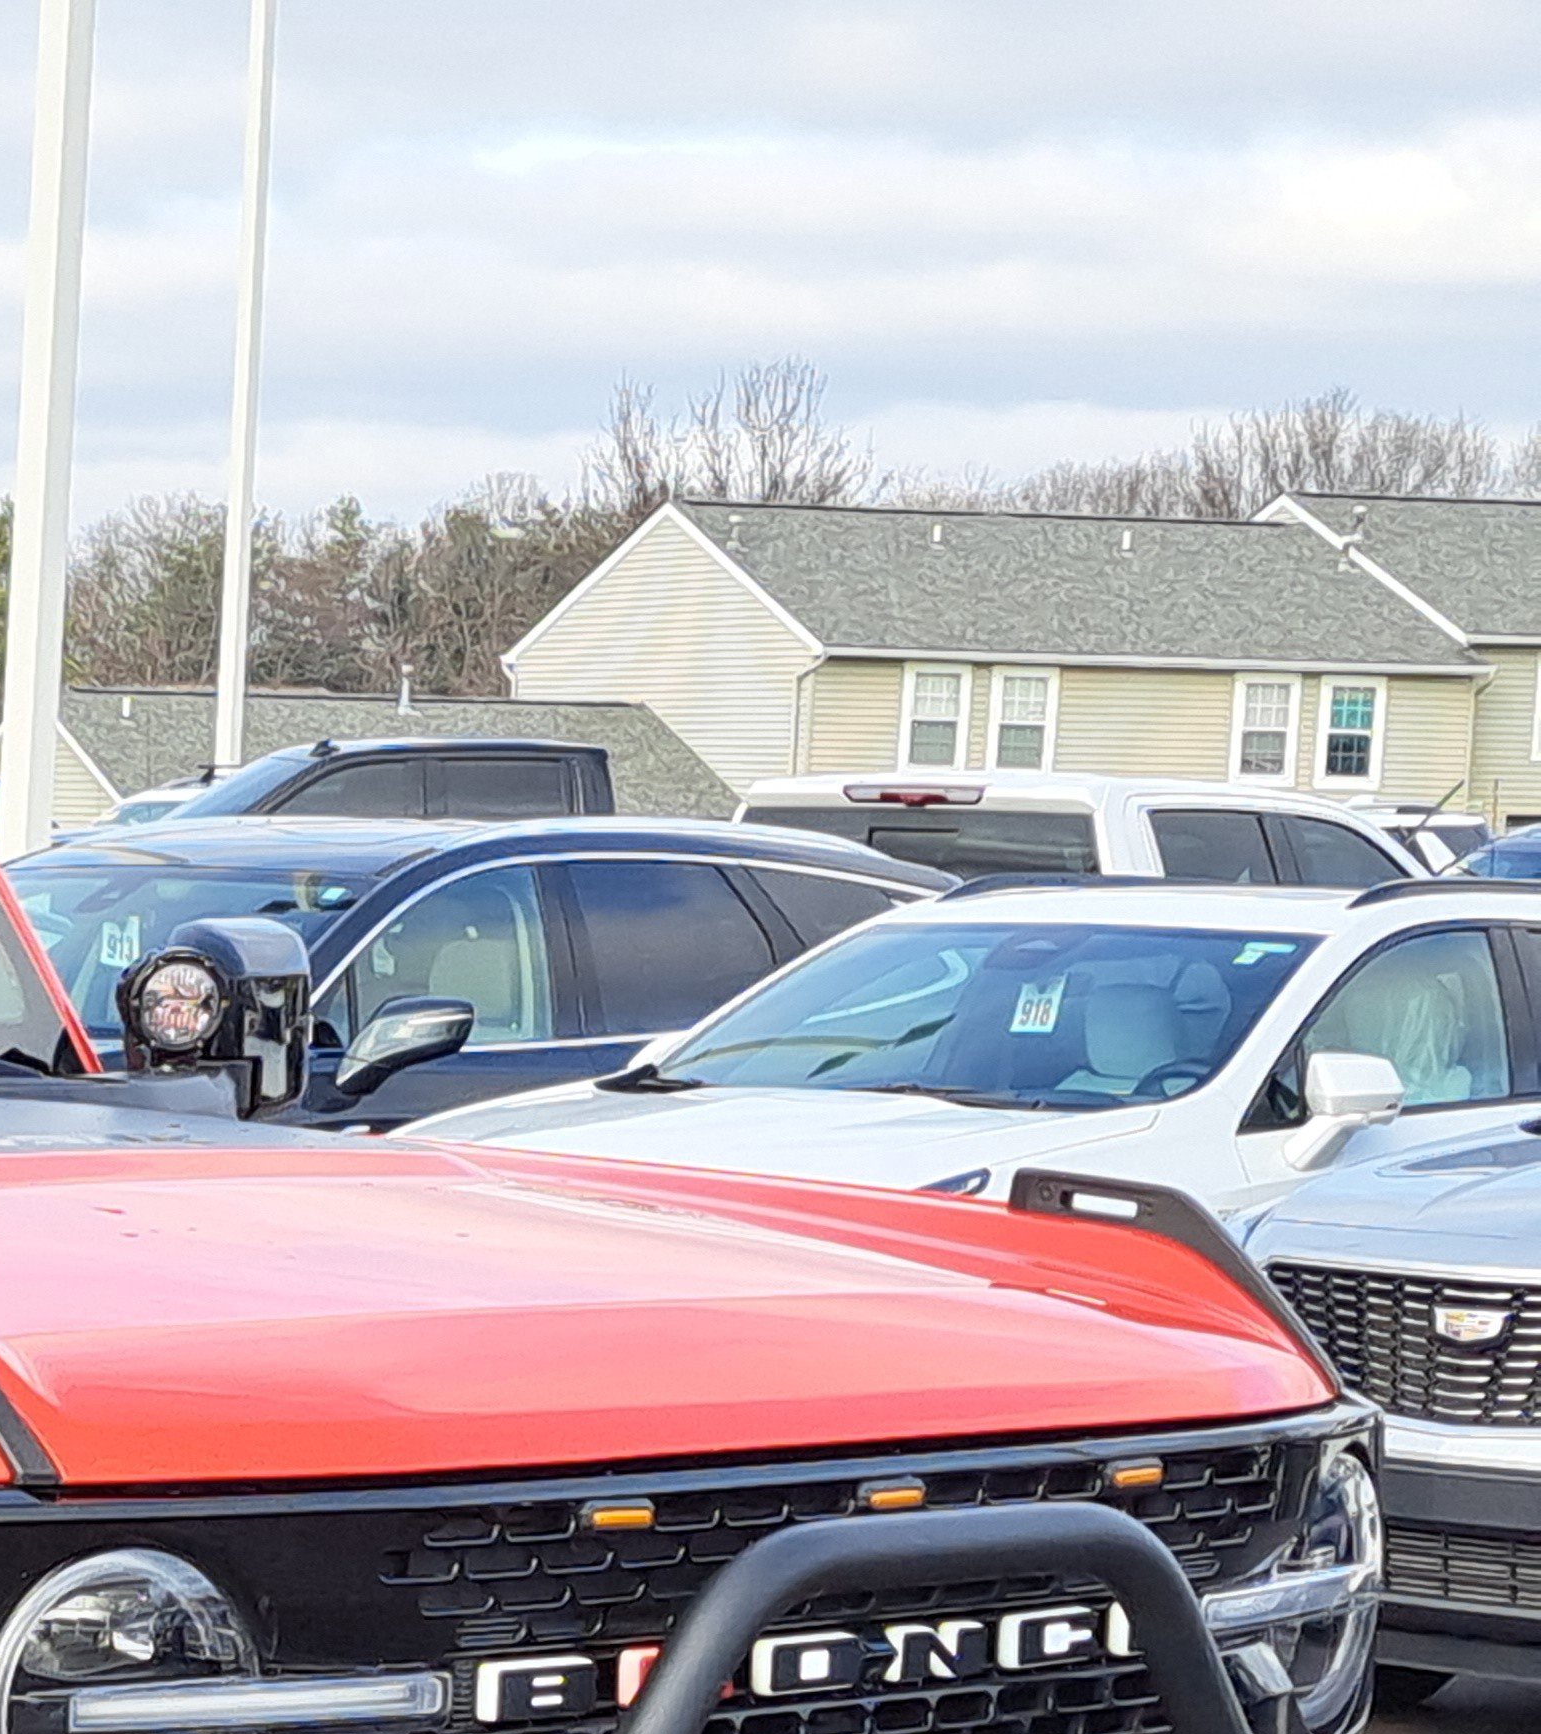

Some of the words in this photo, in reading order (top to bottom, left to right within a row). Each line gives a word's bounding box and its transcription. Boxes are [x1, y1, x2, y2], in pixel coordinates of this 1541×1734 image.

[106, 932, 134, 961] 913
[1018, 997, 1053, 1027] 918
[474, 1600, 1131, 1723] BONC
